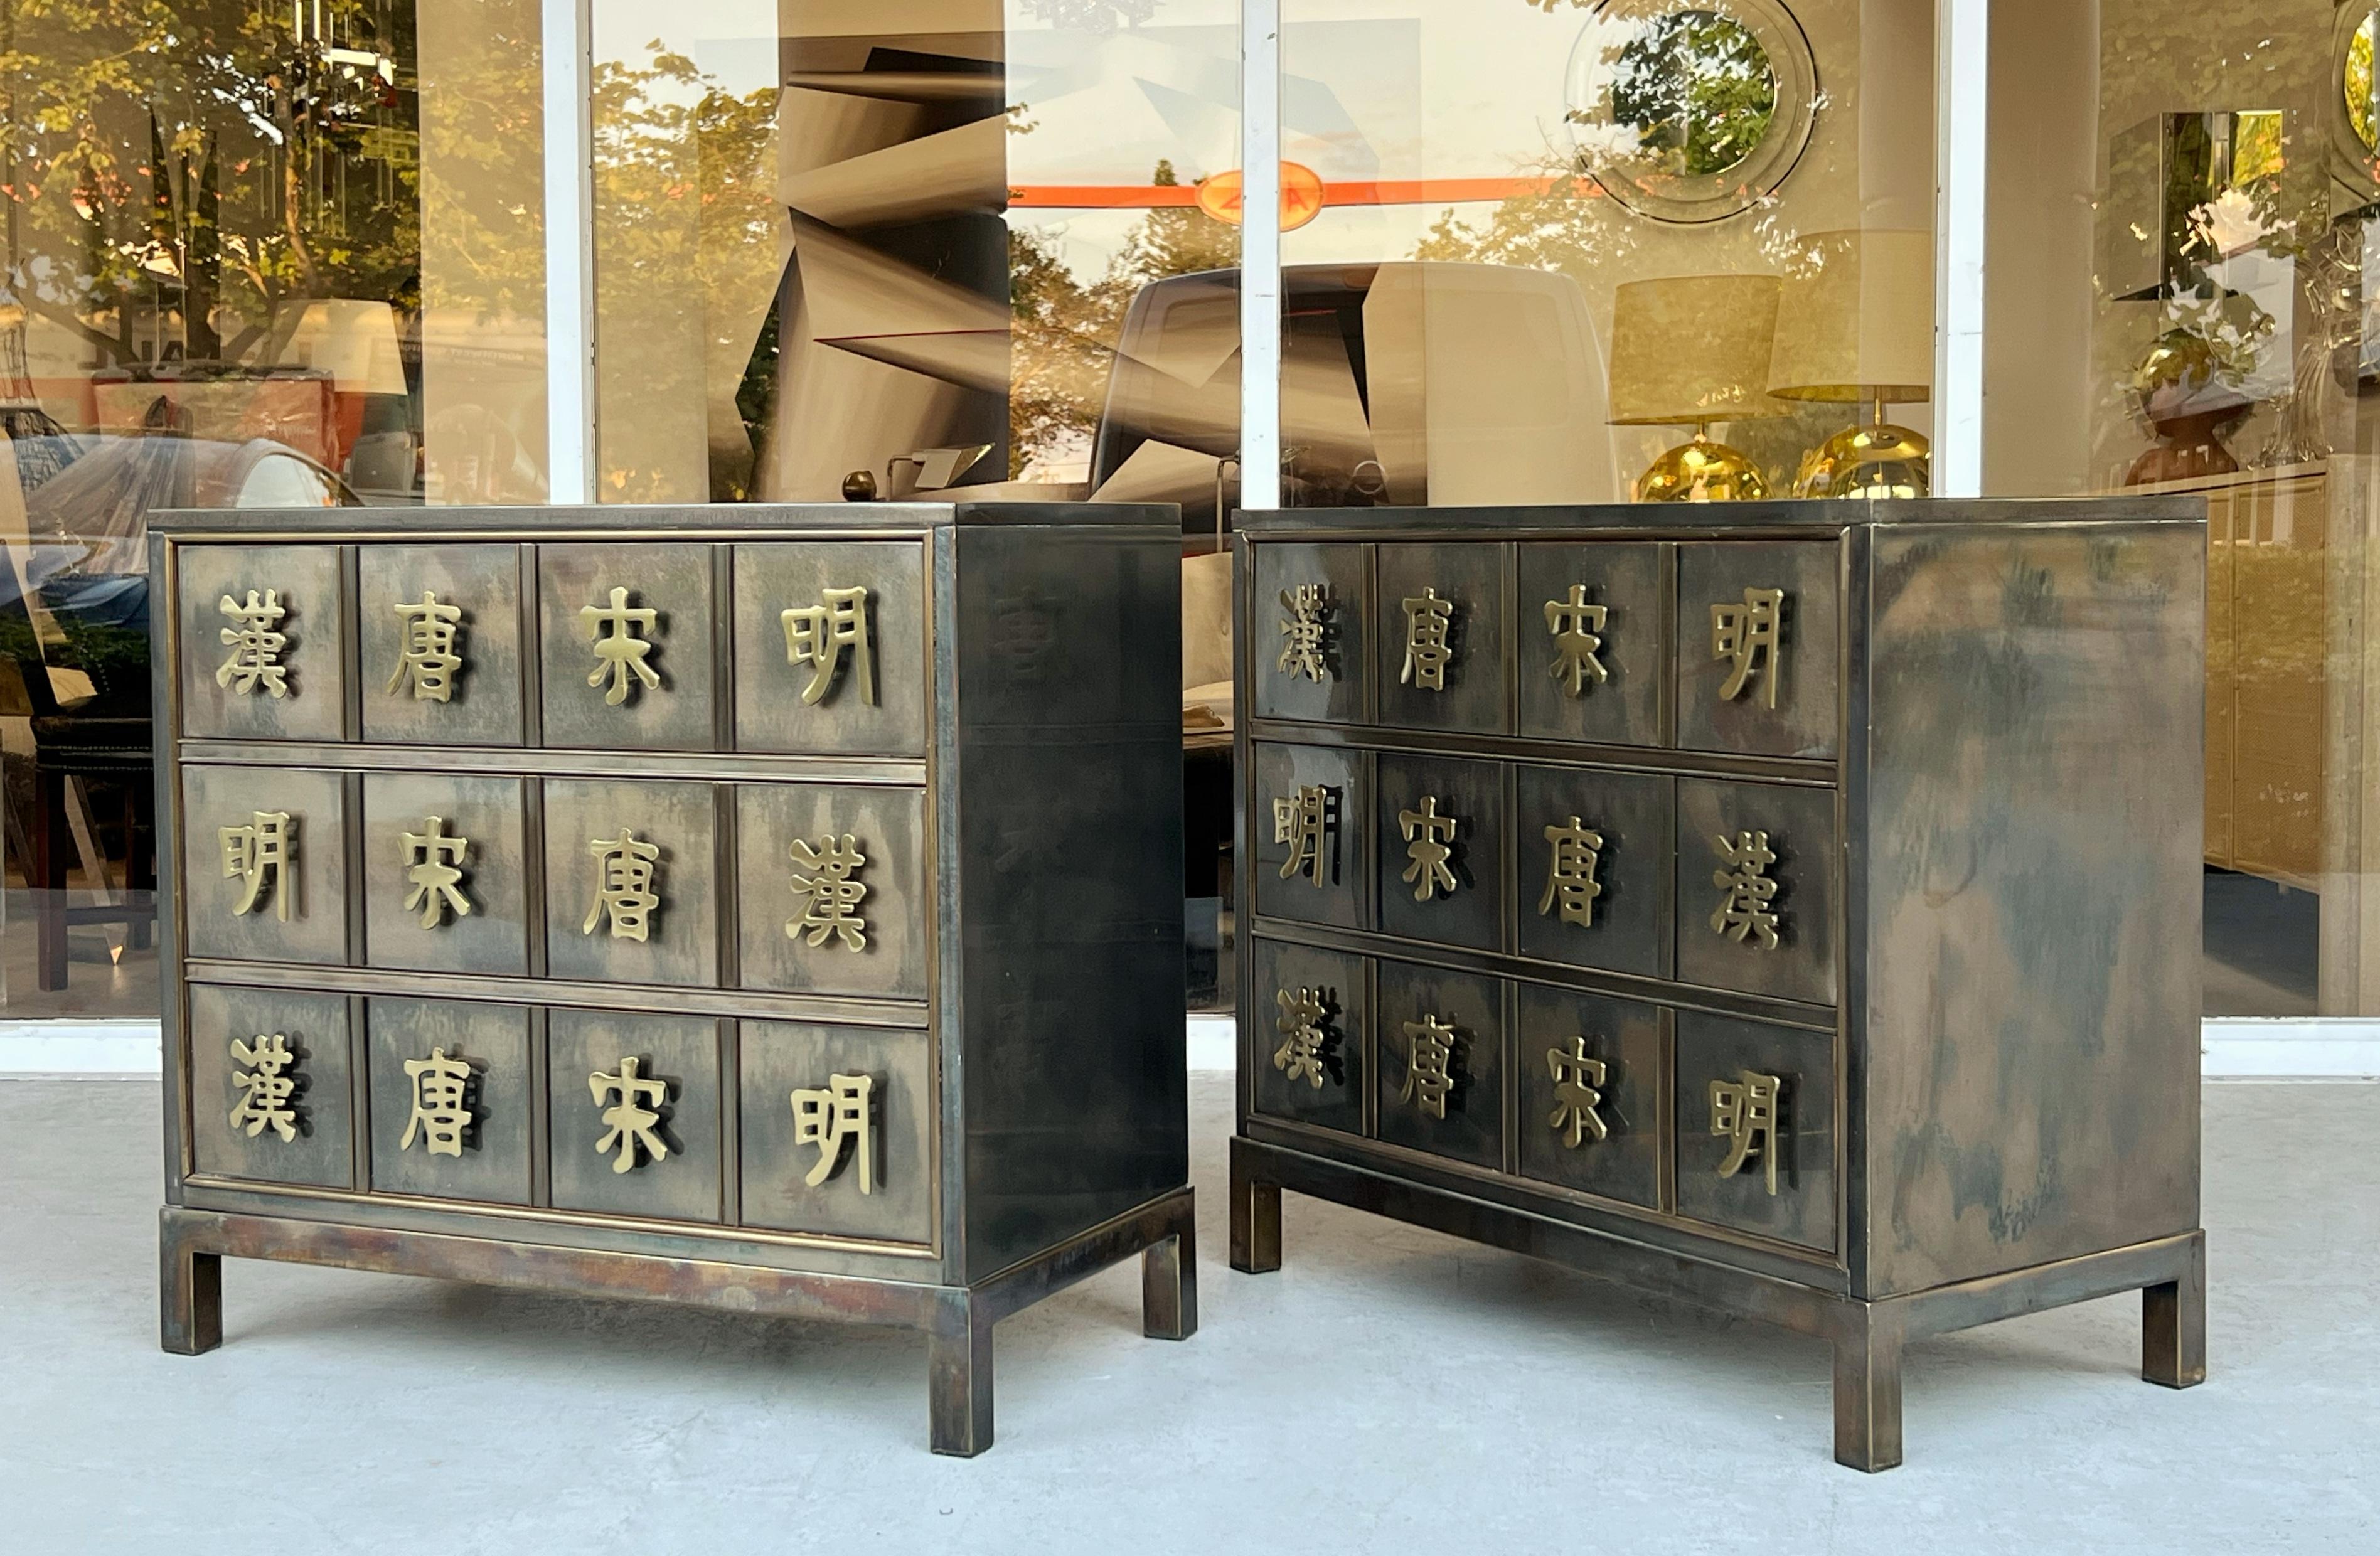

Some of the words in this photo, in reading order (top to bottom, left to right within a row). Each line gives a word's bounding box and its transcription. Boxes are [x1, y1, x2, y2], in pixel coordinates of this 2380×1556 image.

[215, 587, 289, 700] 漢
[386, 590, 463, 703] 唐
[580, 586, 660, 707] 宋
[780, 585, 874, 706] 明
[1276, 584, 1326, 685] 漢
[1399, 586, 1454, 692] 唐
[1544, 584, 1609, 698] 宋
[1710, 587, 1785, 710] 明
[217, 809, 291, 922] 明
[397, 816, 471, 931] 宋
[582, 827, 660, 943] 唐
[784, 833, 867, 954] 漢
[1273, 784, 1326, 888] 明
[1398, 795, 1458, 902] 宋
[1538, 816, 1604, 929] 唐
[1710, 831, 1780, 952] 漢
[228, 1033, 297, 1144] 漢
[400, 1046, 472, 1158] 唐
[588, 1056, 669, 1175] 宋
[791, 1074, 873, 1196] 明
[1273, 987, 1325, 1090] 漢
[1400, 1013, 1454, 1122] 唐
[1547, 1036, 1609, 1149] 宋
[1709, 1070, 1782, 1196] 明
